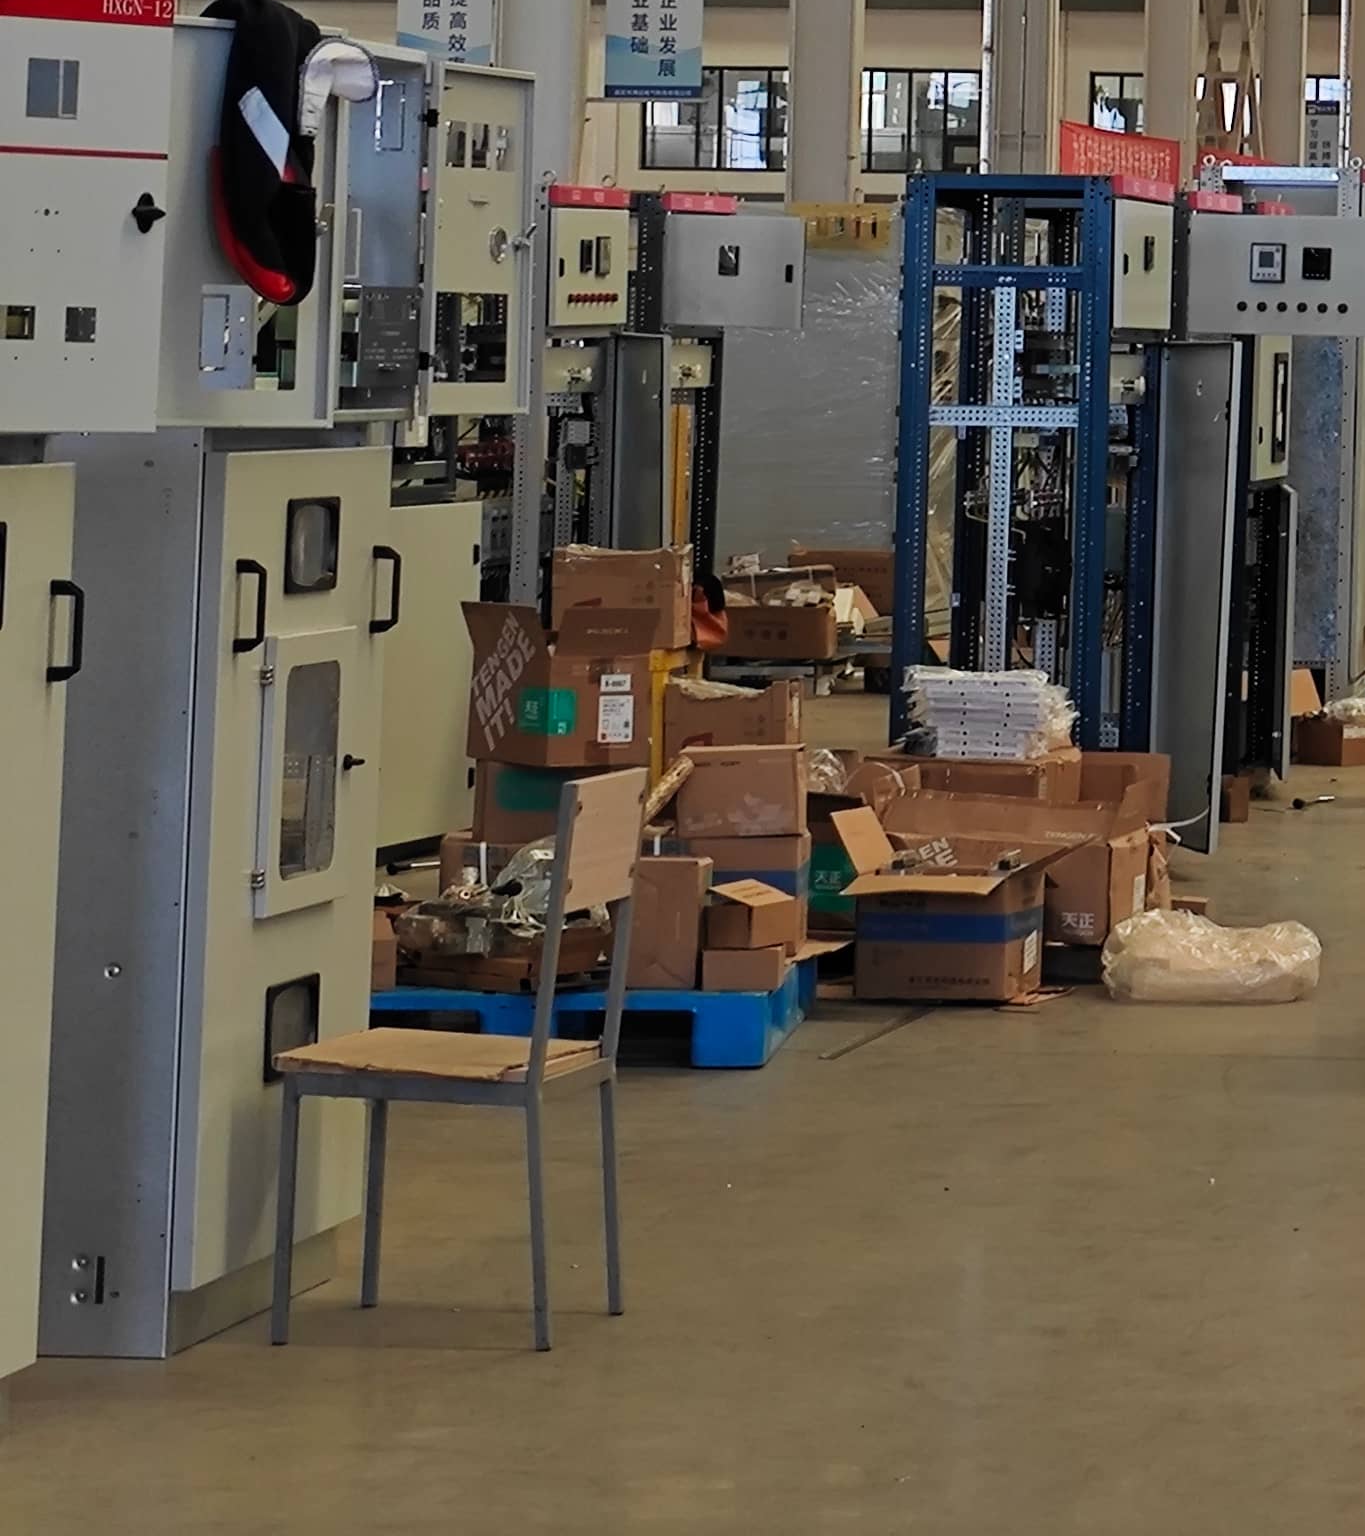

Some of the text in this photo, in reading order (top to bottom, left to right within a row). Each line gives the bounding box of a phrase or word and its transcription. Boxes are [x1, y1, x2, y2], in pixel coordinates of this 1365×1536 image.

[472, 611, 520, 696] TENGEN
[475, 628, 536, 725] MADE
[484, 700, 515, 751] IT!
[1061, 911, 1095, 929] 天正
